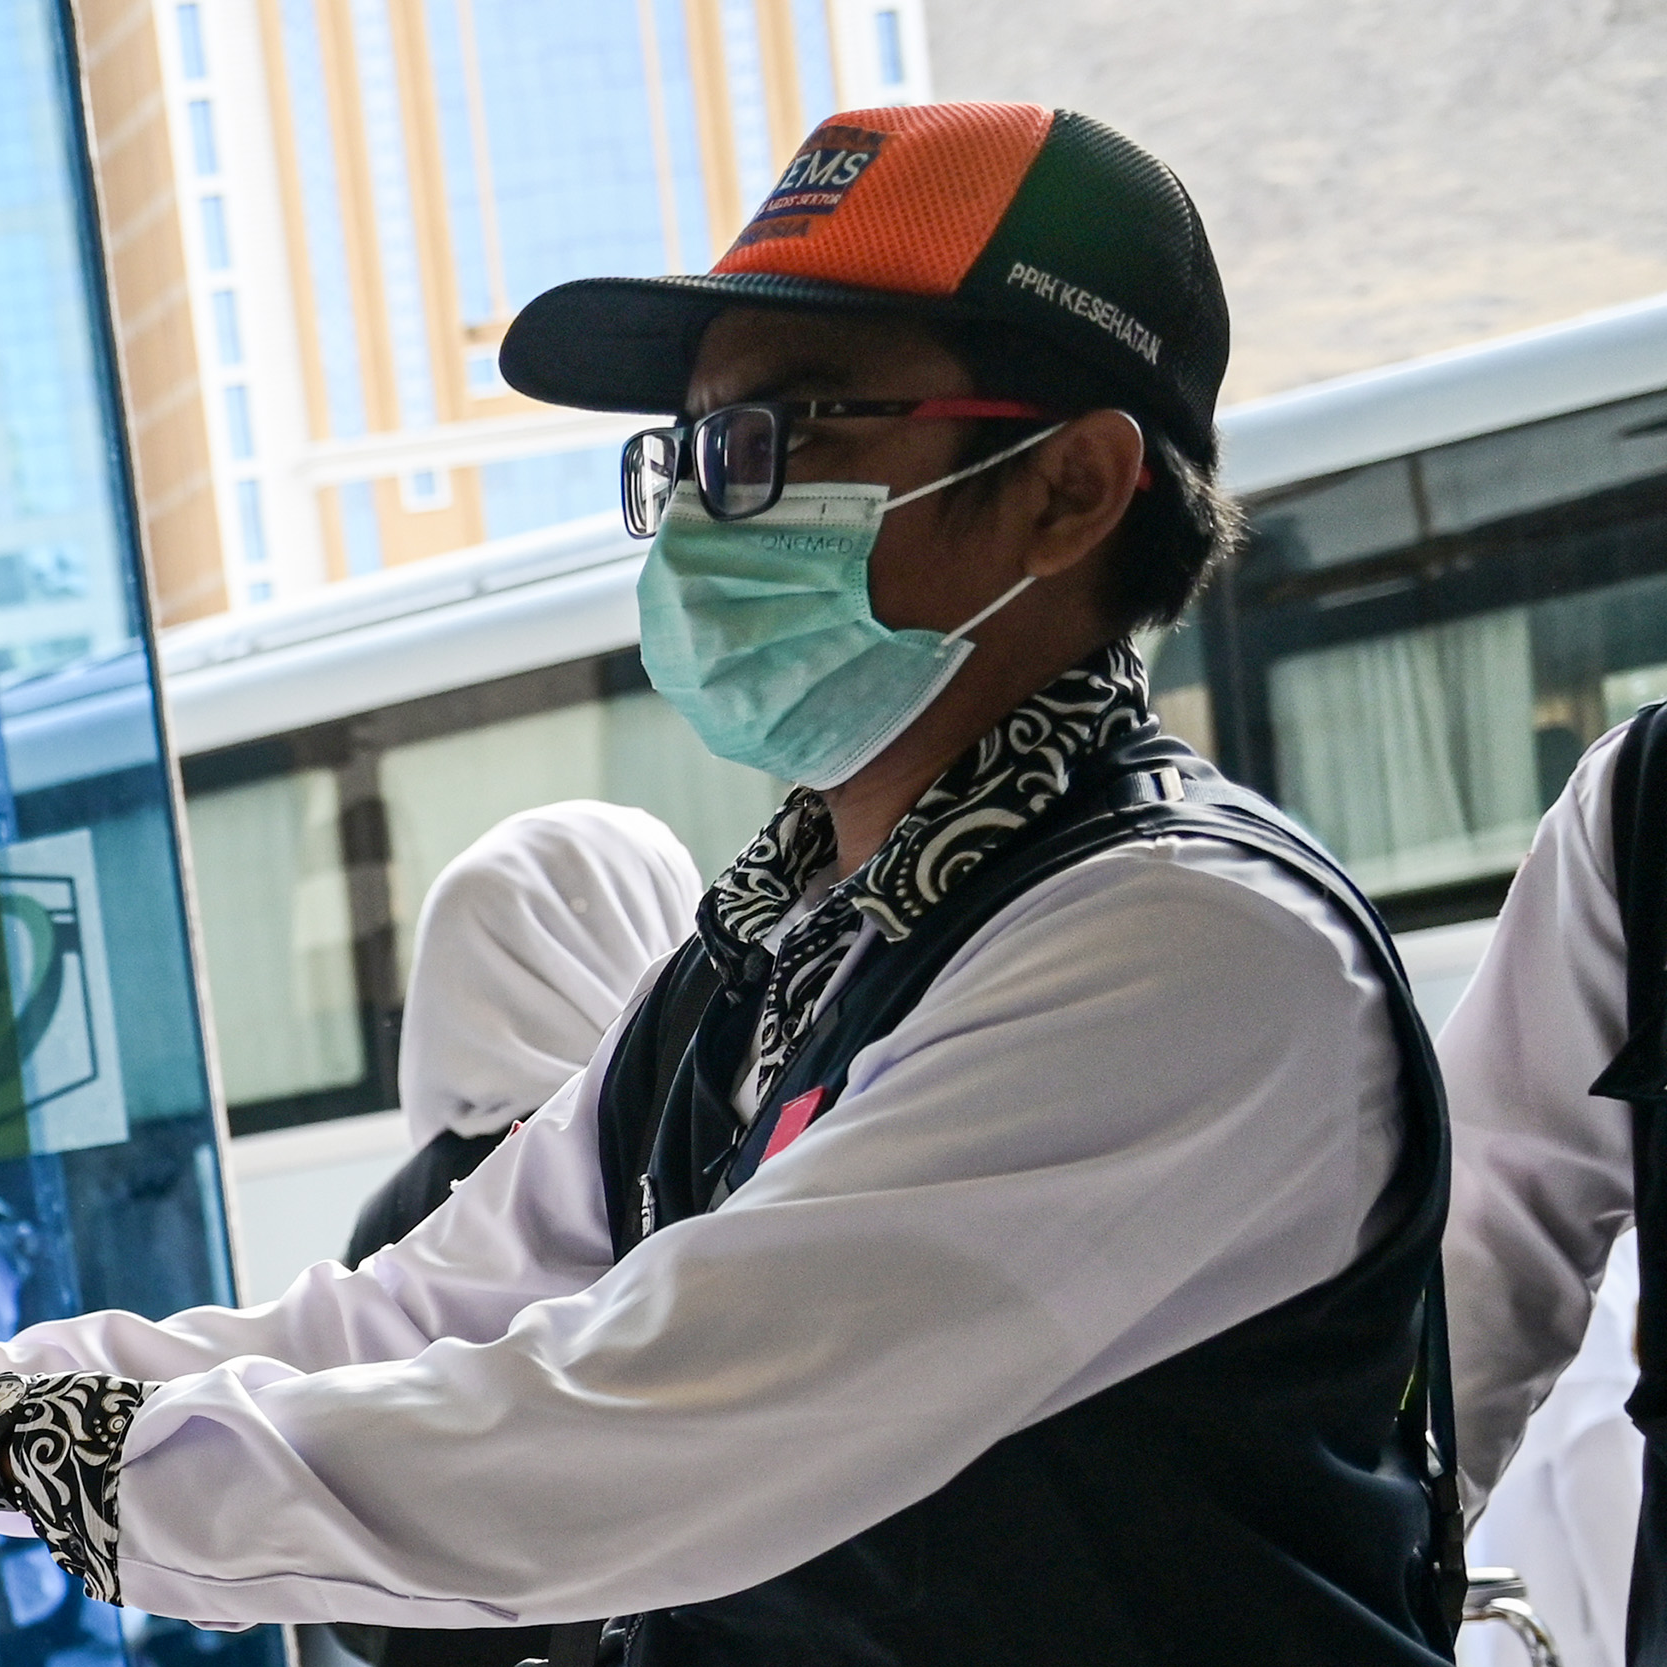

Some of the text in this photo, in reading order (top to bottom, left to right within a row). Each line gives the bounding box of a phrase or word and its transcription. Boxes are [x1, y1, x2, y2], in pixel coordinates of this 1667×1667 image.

[779, 150, 869, 190] EMS
[1007, 262, 1163, 366] PPIH KESEHATAN
